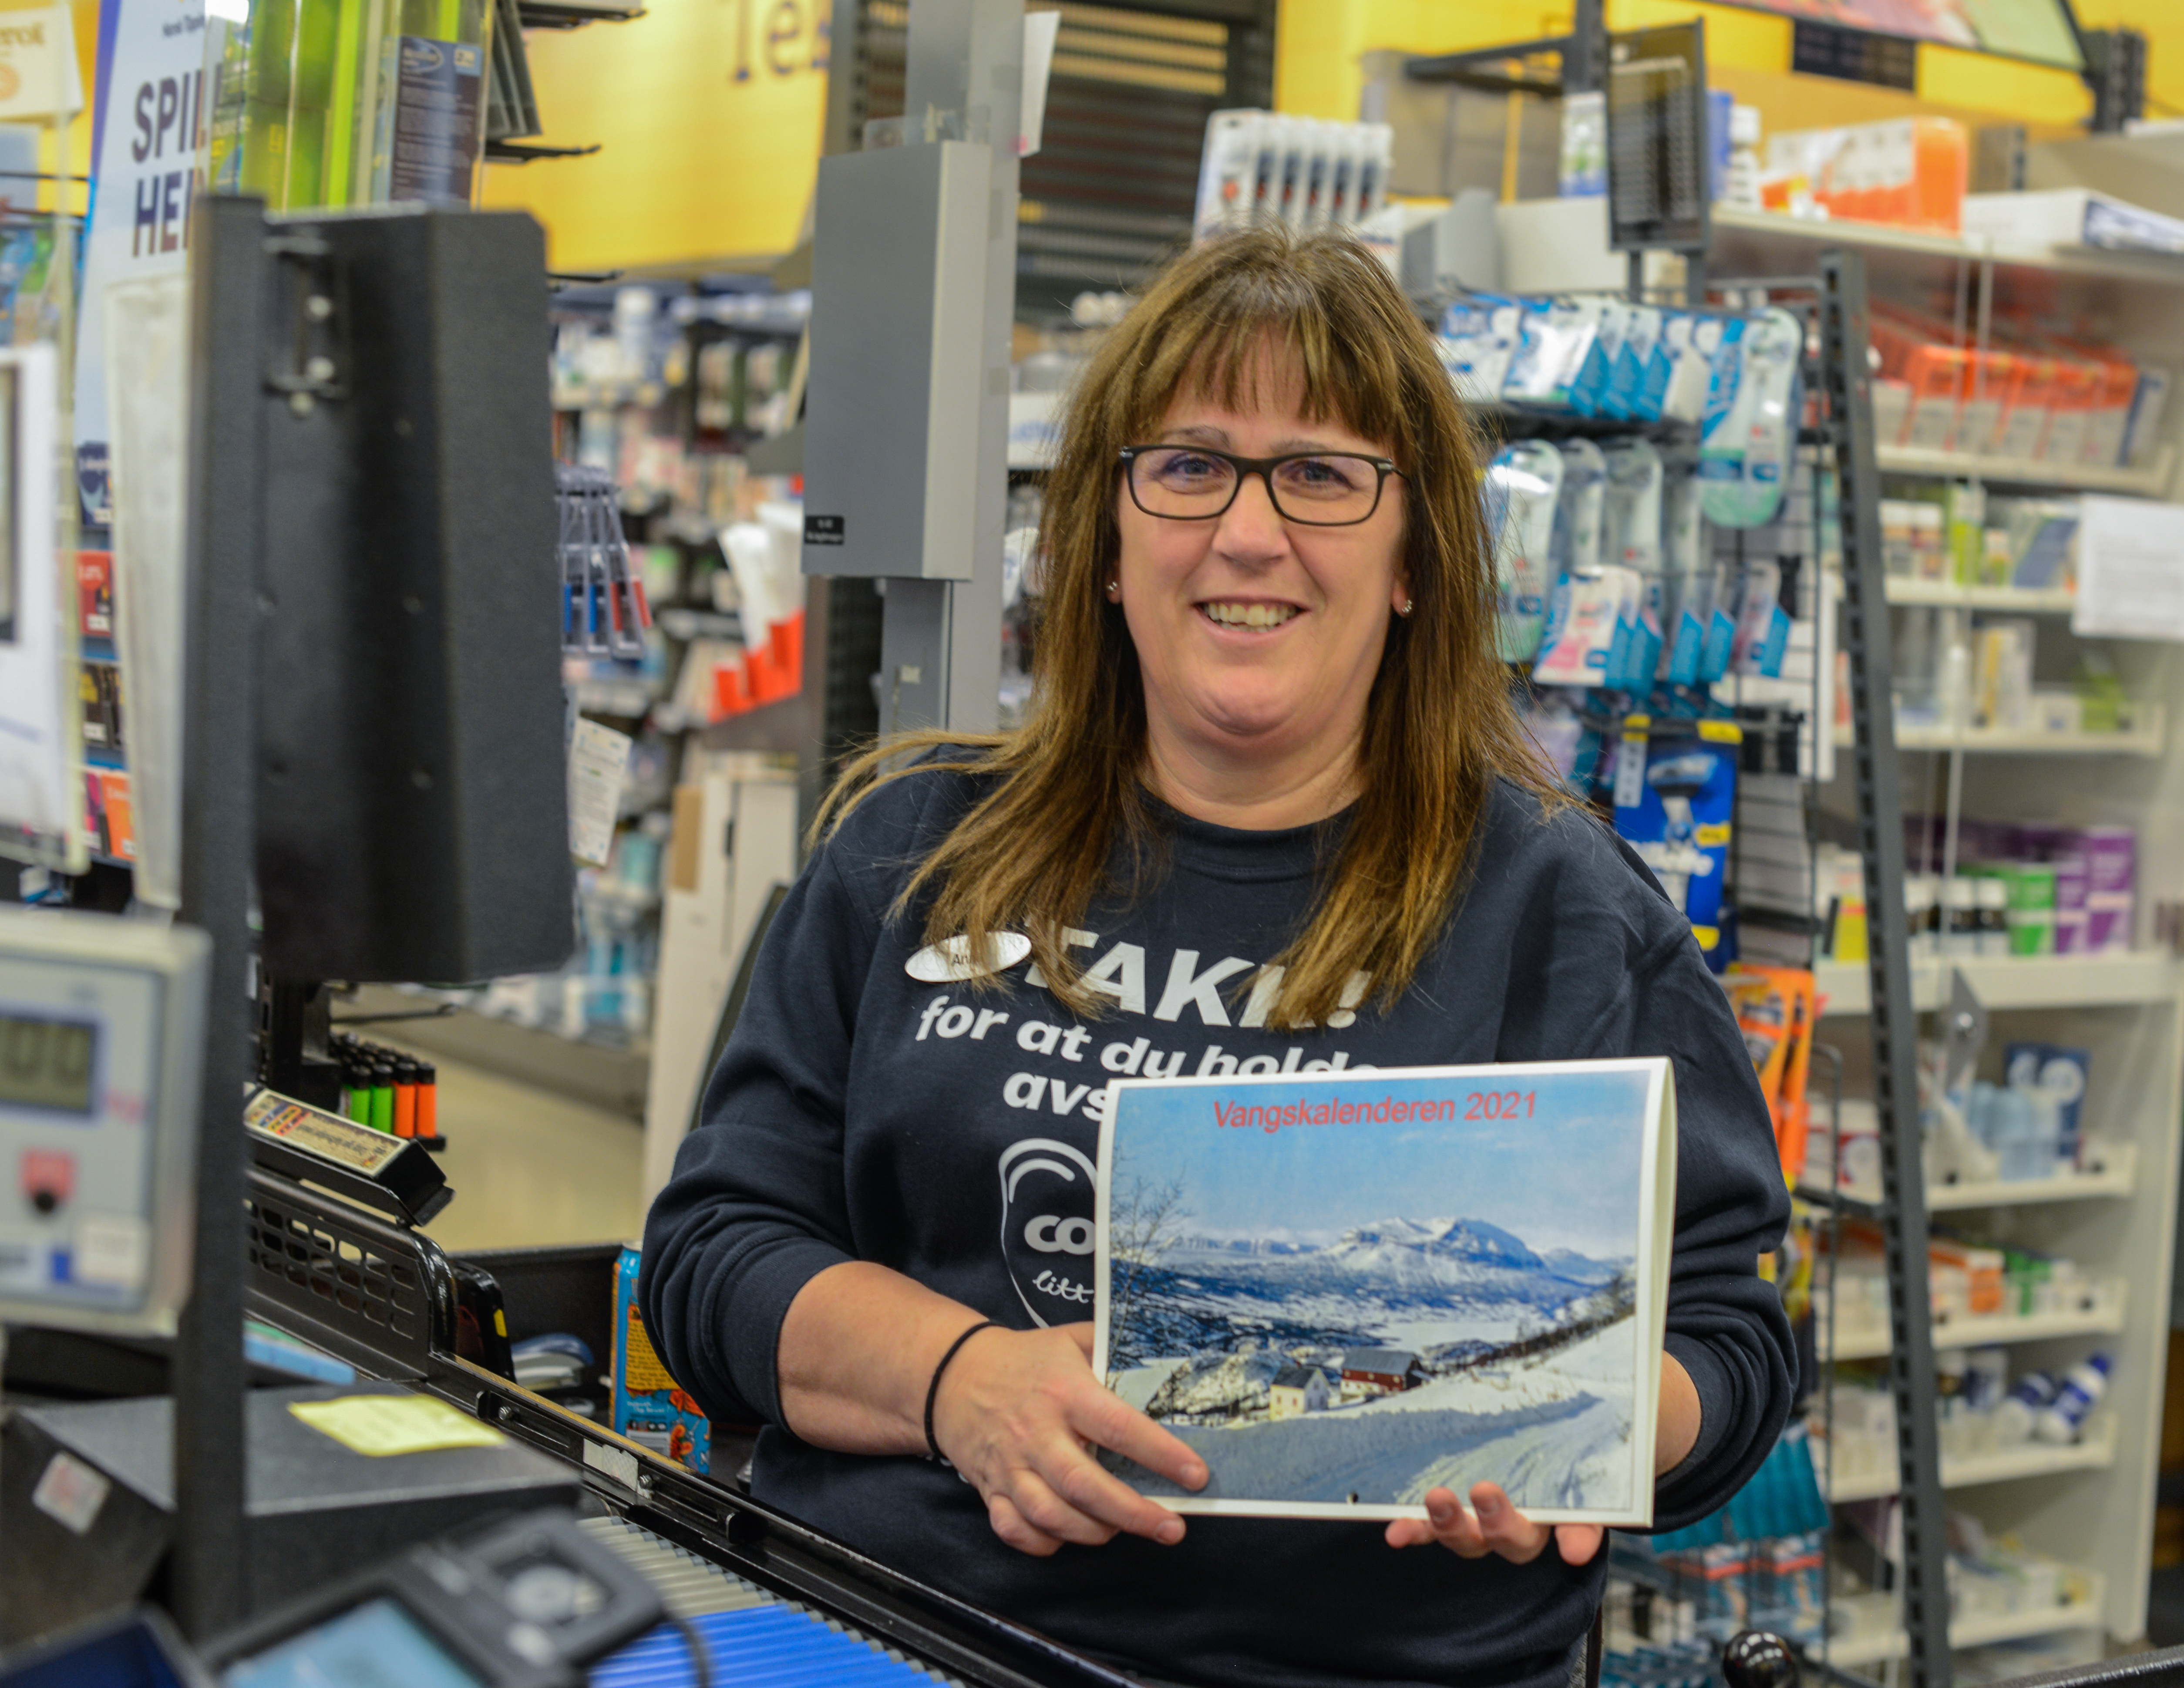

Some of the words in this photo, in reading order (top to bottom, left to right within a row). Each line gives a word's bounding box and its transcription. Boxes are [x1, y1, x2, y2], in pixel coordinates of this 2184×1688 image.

[915, 995, 1010, 1041] for
[1016, 1020, 1092, 1062] at
[1100, 1036, 1187, 1078] du
[1213, 1096, 1455, 1133] Vangskalenderen
[1464, 1090, 1537, 1120] 2021
